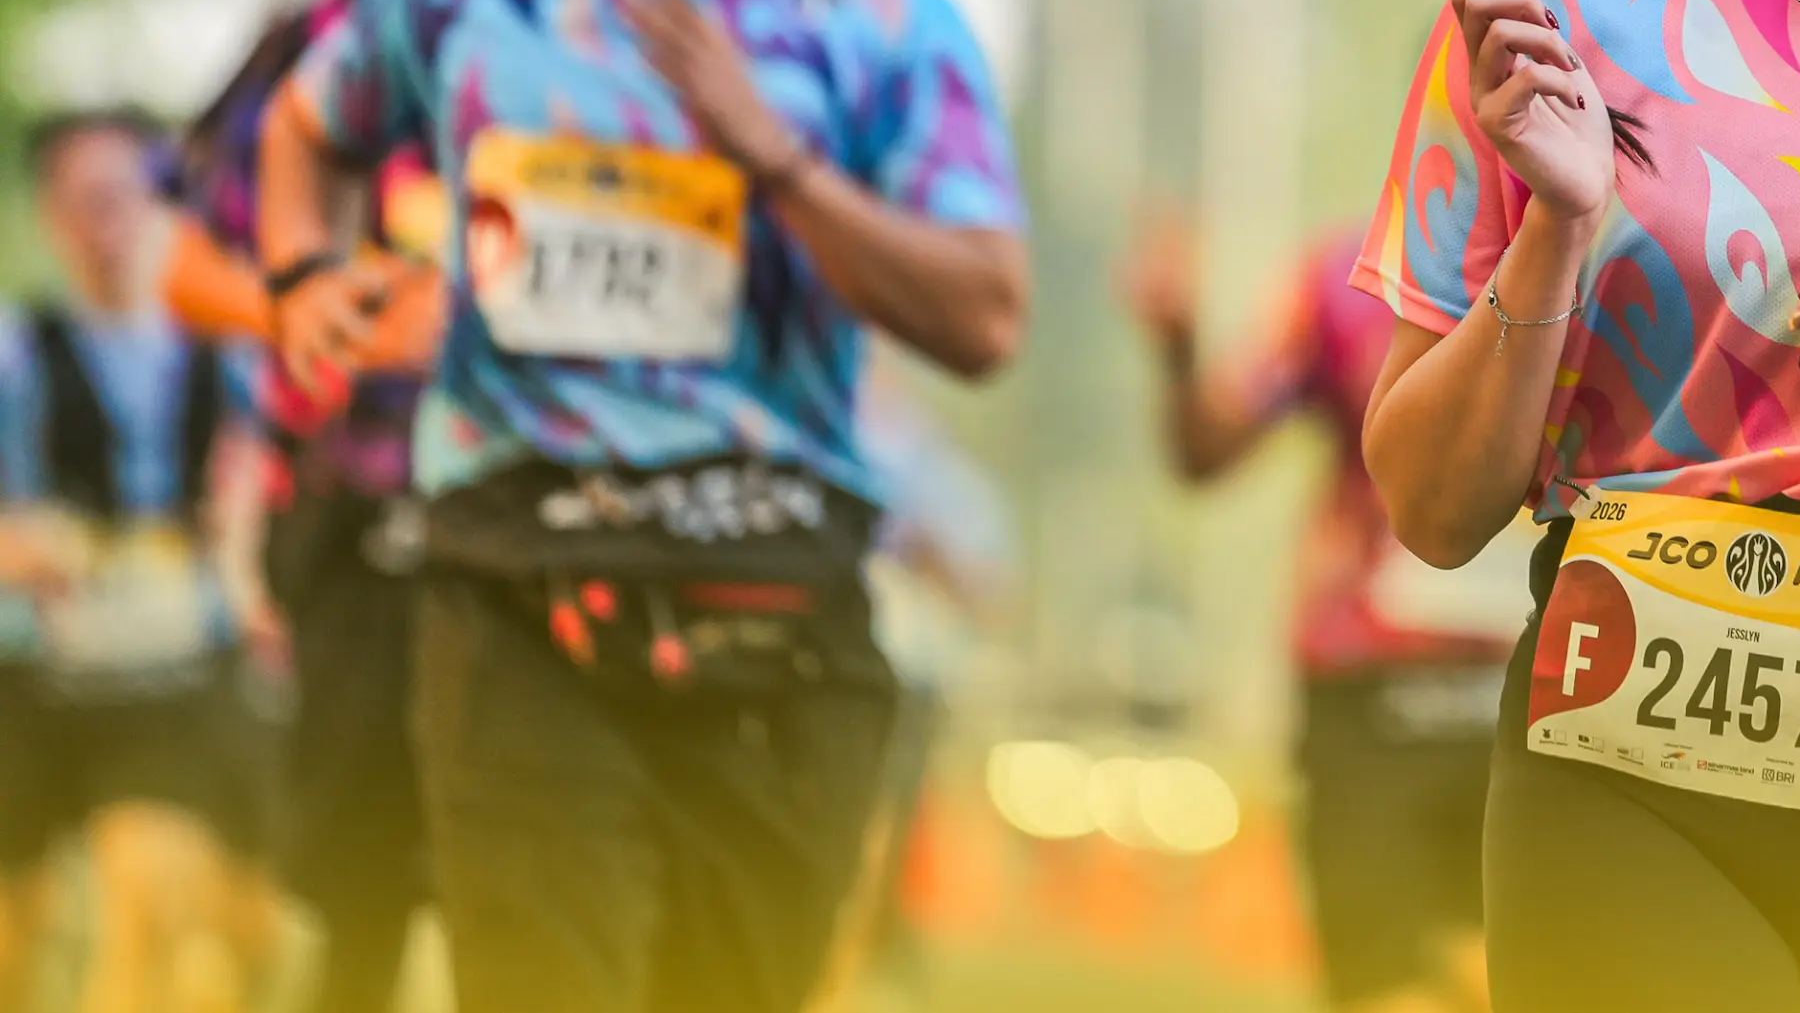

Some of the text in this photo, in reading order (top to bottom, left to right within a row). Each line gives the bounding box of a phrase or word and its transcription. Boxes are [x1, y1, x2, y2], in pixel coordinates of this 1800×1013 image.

[1590, 501, 1627, 521] 2026
[1627, 532, 1717, 569] JCO
[1726, 627, 1760, 643] JESSLYN
[1562, 621, 1599, 696] F
[1776, 770, 1795, 784] BRI
